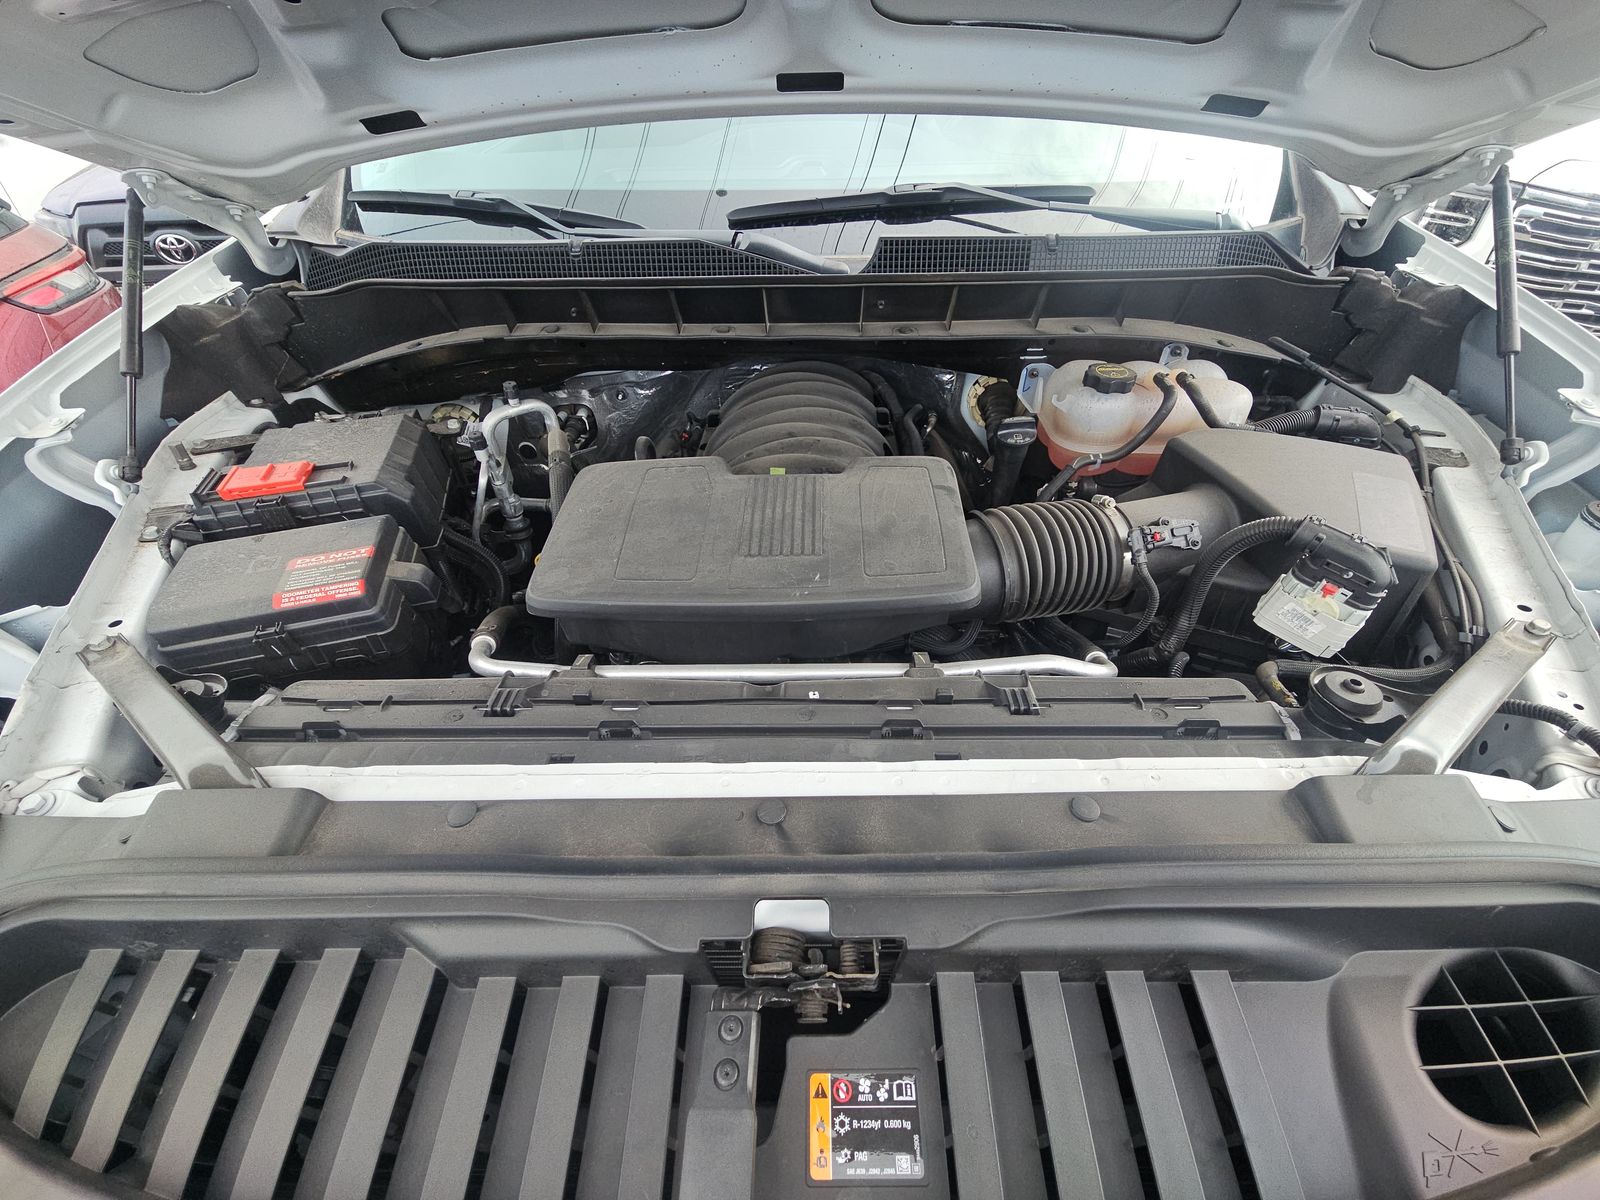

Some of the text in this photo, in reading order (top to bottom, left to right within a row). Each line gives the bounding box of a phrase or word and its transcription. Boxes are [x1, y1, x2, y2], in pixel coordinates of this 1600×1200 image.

[296, 548, 370, 564] DO NOT
[281, 581, 359, 598] ODOMETER TAMPERING
[296, 591, 326, 600] FEDERAL
[858, 1094, 873, 1102] AUTO
[884, 1120, 902, 1128] 0.600
[903, 1120, 911, 1130] kg
[854, 1151, 868, 1161] PAG
